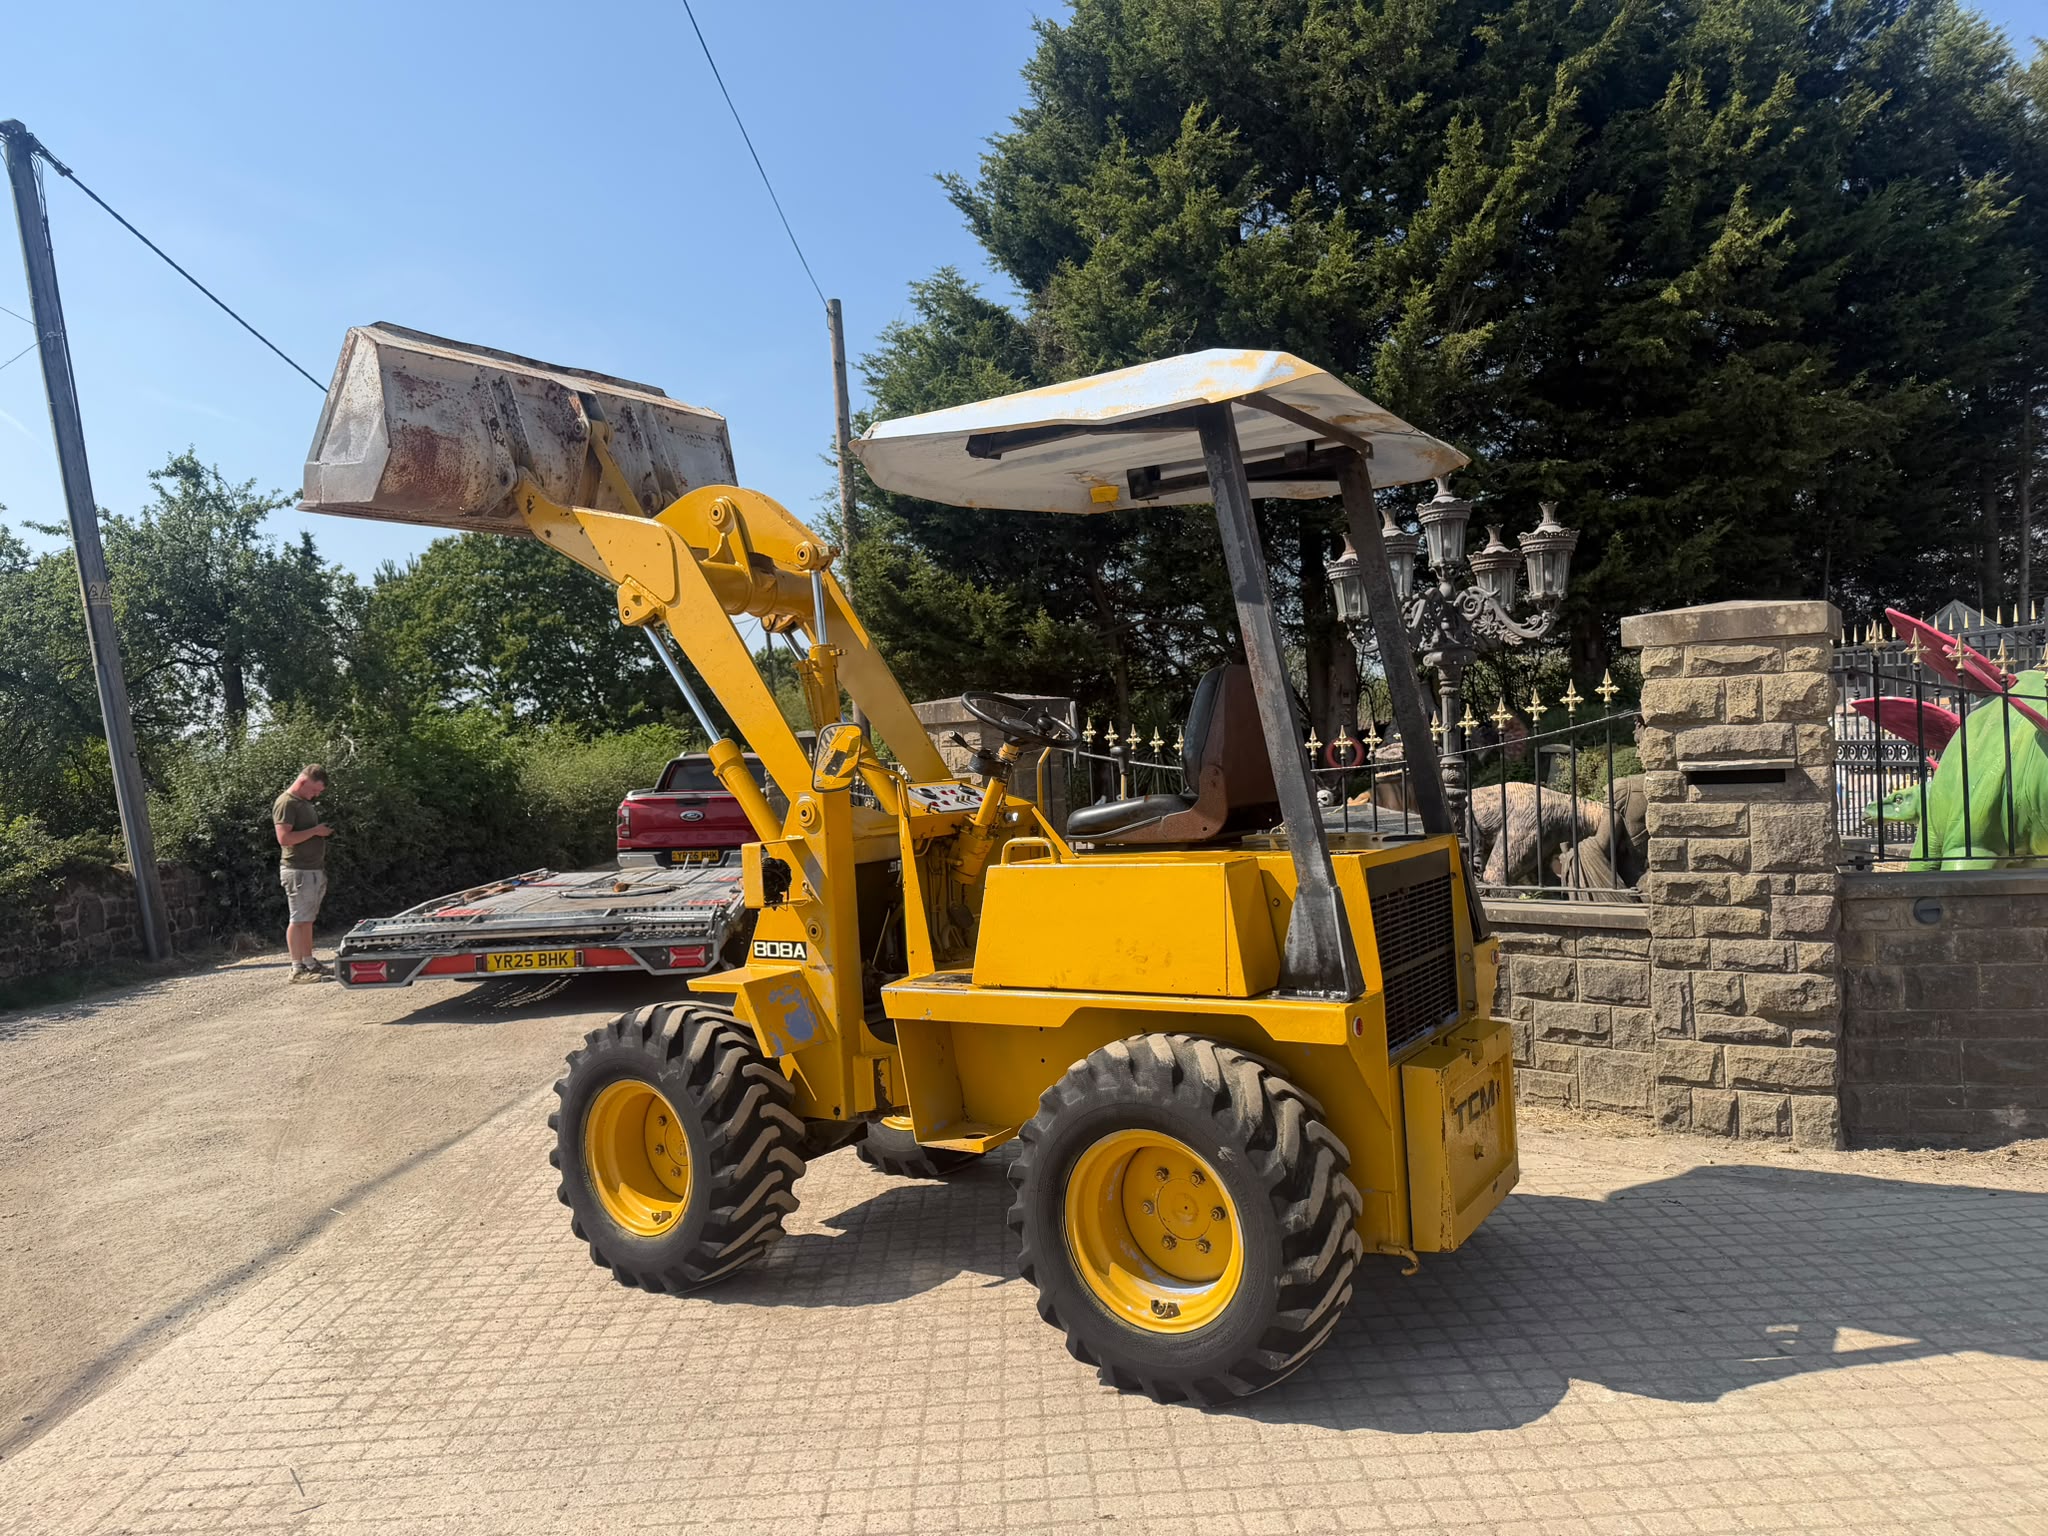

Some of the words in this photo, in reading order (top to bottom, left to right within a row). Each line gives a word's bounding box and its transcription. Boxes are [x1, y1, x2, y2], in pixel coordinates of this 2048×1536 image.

[753, 941, 807, 959] 808A
[493, 953, 534, 969] YR25
[538, 952, 569, 967] BHK
[1453, 1080, 1496, 1134] TCM
